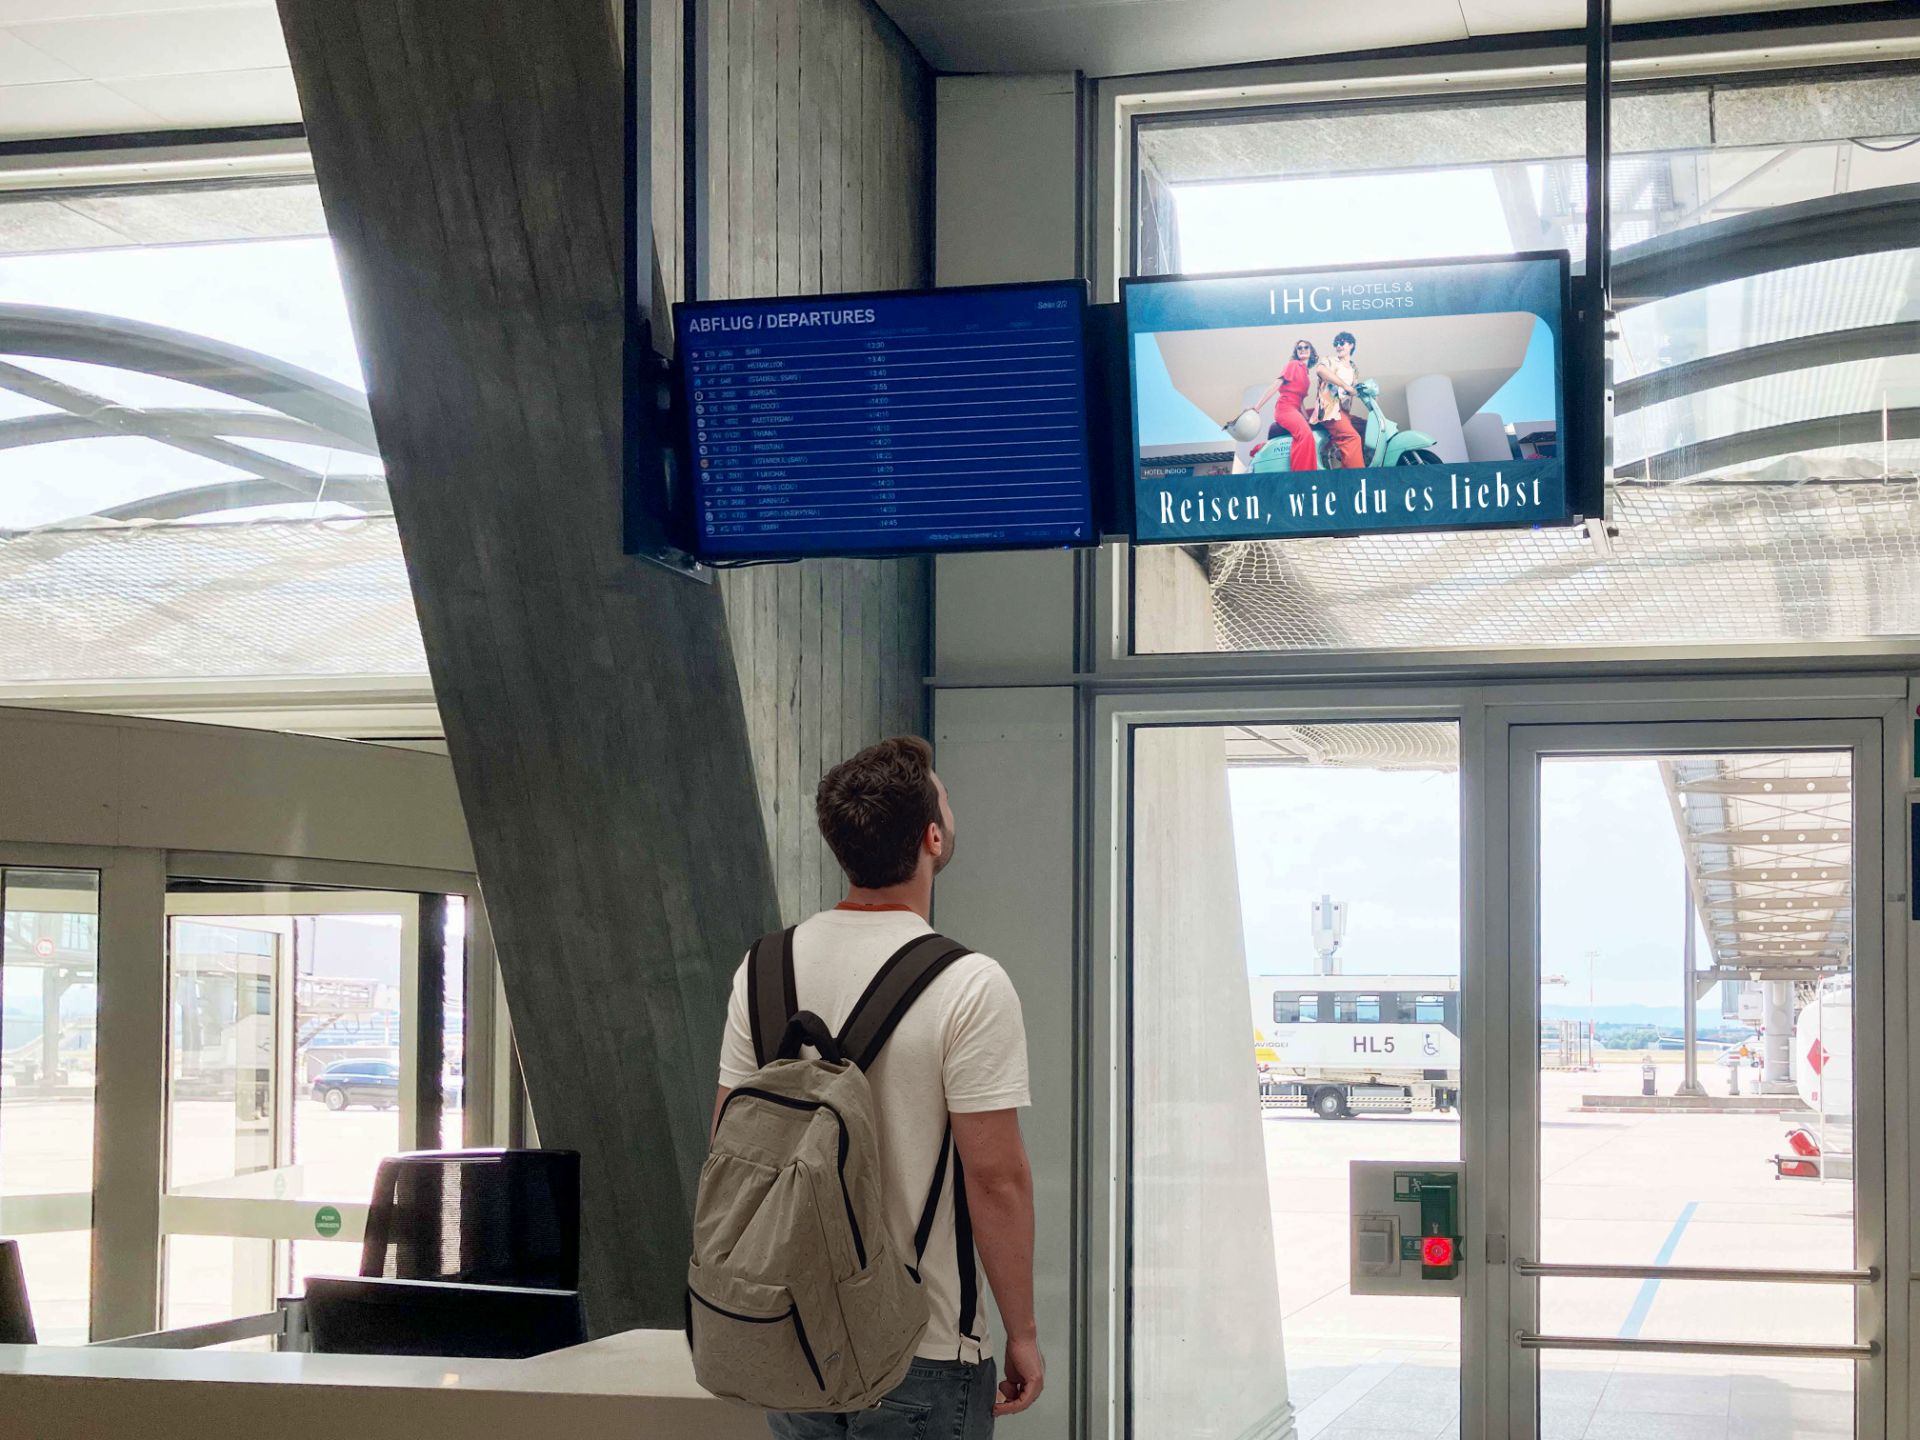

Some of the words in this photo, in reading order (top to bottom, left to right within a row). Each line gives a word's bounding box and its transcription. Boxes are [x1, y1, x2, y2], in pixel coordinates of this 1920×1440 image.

[1341, 282, 1401, 296] HOTELS
[1404, 280, 1414, 293] &
[1269, 286, 1332, 315] IHG
[1342, 296, 1415, 311] RESORTS
[689, 315, 754, 333] ABFLUG
[757, 314, 763, 329] /
[766, 309, 876, 329] DEPARTURES
[1159, 490, 1272, 525] Reisen,
[1288, 484, 1337, 518] wie
[1354, 478, 1387, 514] du
[1404, 485, 1434, 513] es
[1450, 471, 1542, 510] liebst
[1353, 1035, 1395, 1053] HL5
